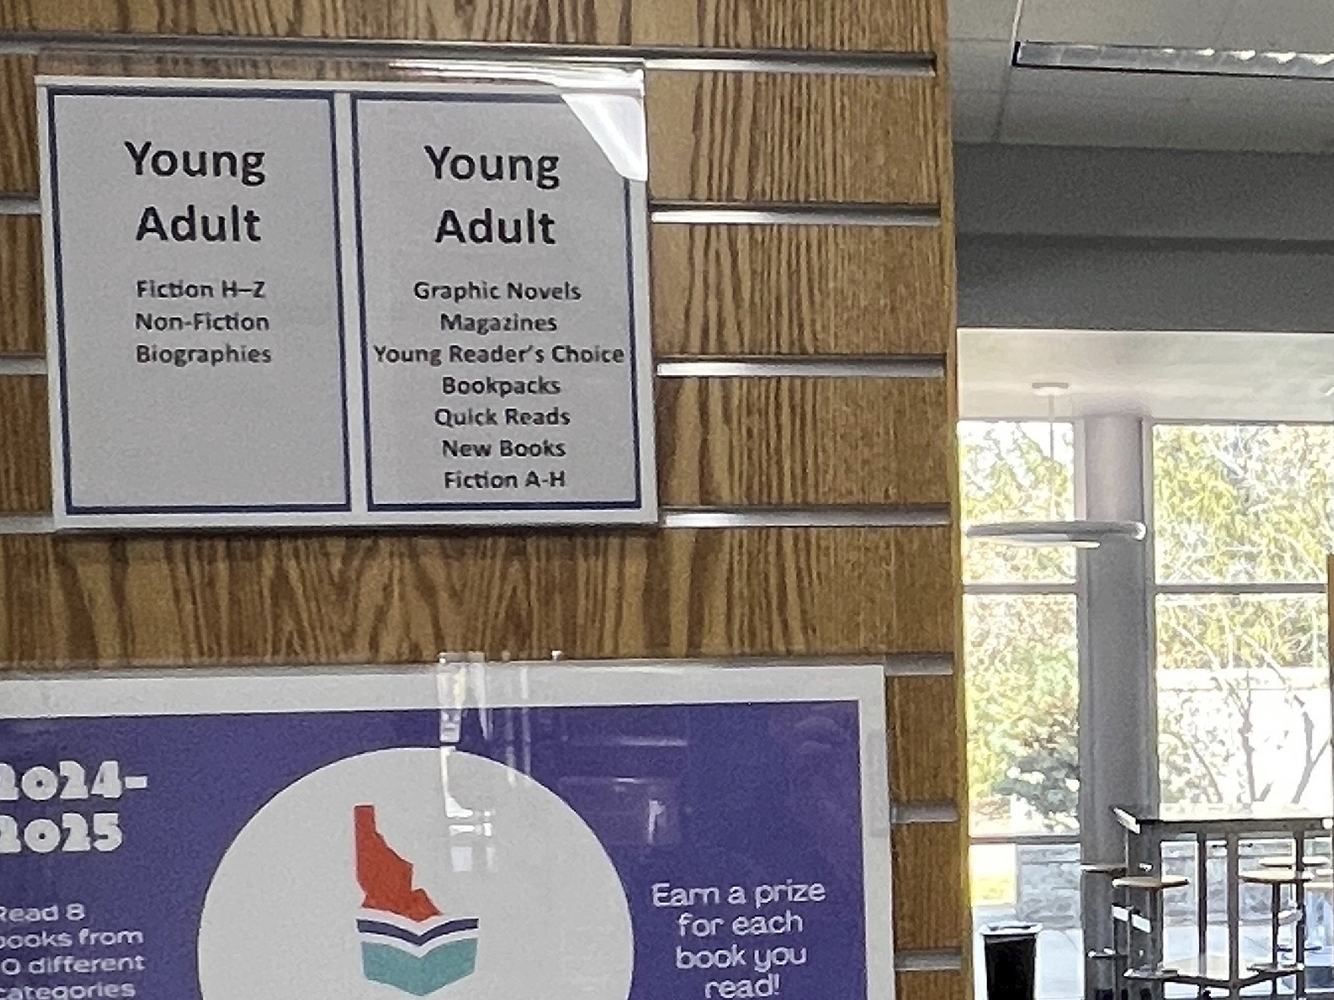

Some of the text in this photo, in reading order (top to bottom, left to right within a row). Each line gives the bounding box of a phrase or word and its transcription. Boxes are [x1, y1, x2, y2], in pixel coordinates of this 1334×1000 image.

[125, 141, 266, 185] Young
[424, 145, 561, 189] Young
[135, 206, 263, 242] Adult
[435, 209, 557, 245] Adult
[136, 279, 216, 300] Fiction
[414, 281, 582, 302] Graphic Novels
[135, 311, 270, 332] Non-Fiction
[440, 313, 557, 335] Magazines
[136, 344, 272, 366] Biographies
[373, 345, 442, 366] Young
[551, 344, 625, 363] Choice
[442, 376, 562, 397] Bookpacks
[434, 407, 571, 429] Quick Reads
[442, 438, 567, 458] New Books
[444, 470, 566, 490] Fiction A-H
[0, 760, 148, 800] 2024-
[0, 812, 123, 852] 2025
[651, 879, 827, 909] Earn a prize
[65, 903, 85, 921] 8
[678, 909, 804, 937] for each
[78, 928, 144, 945] from
[27, 955, 146, 974] different
[675, 944, 807, 973] book you
[704, 974, 780, 999] read!
